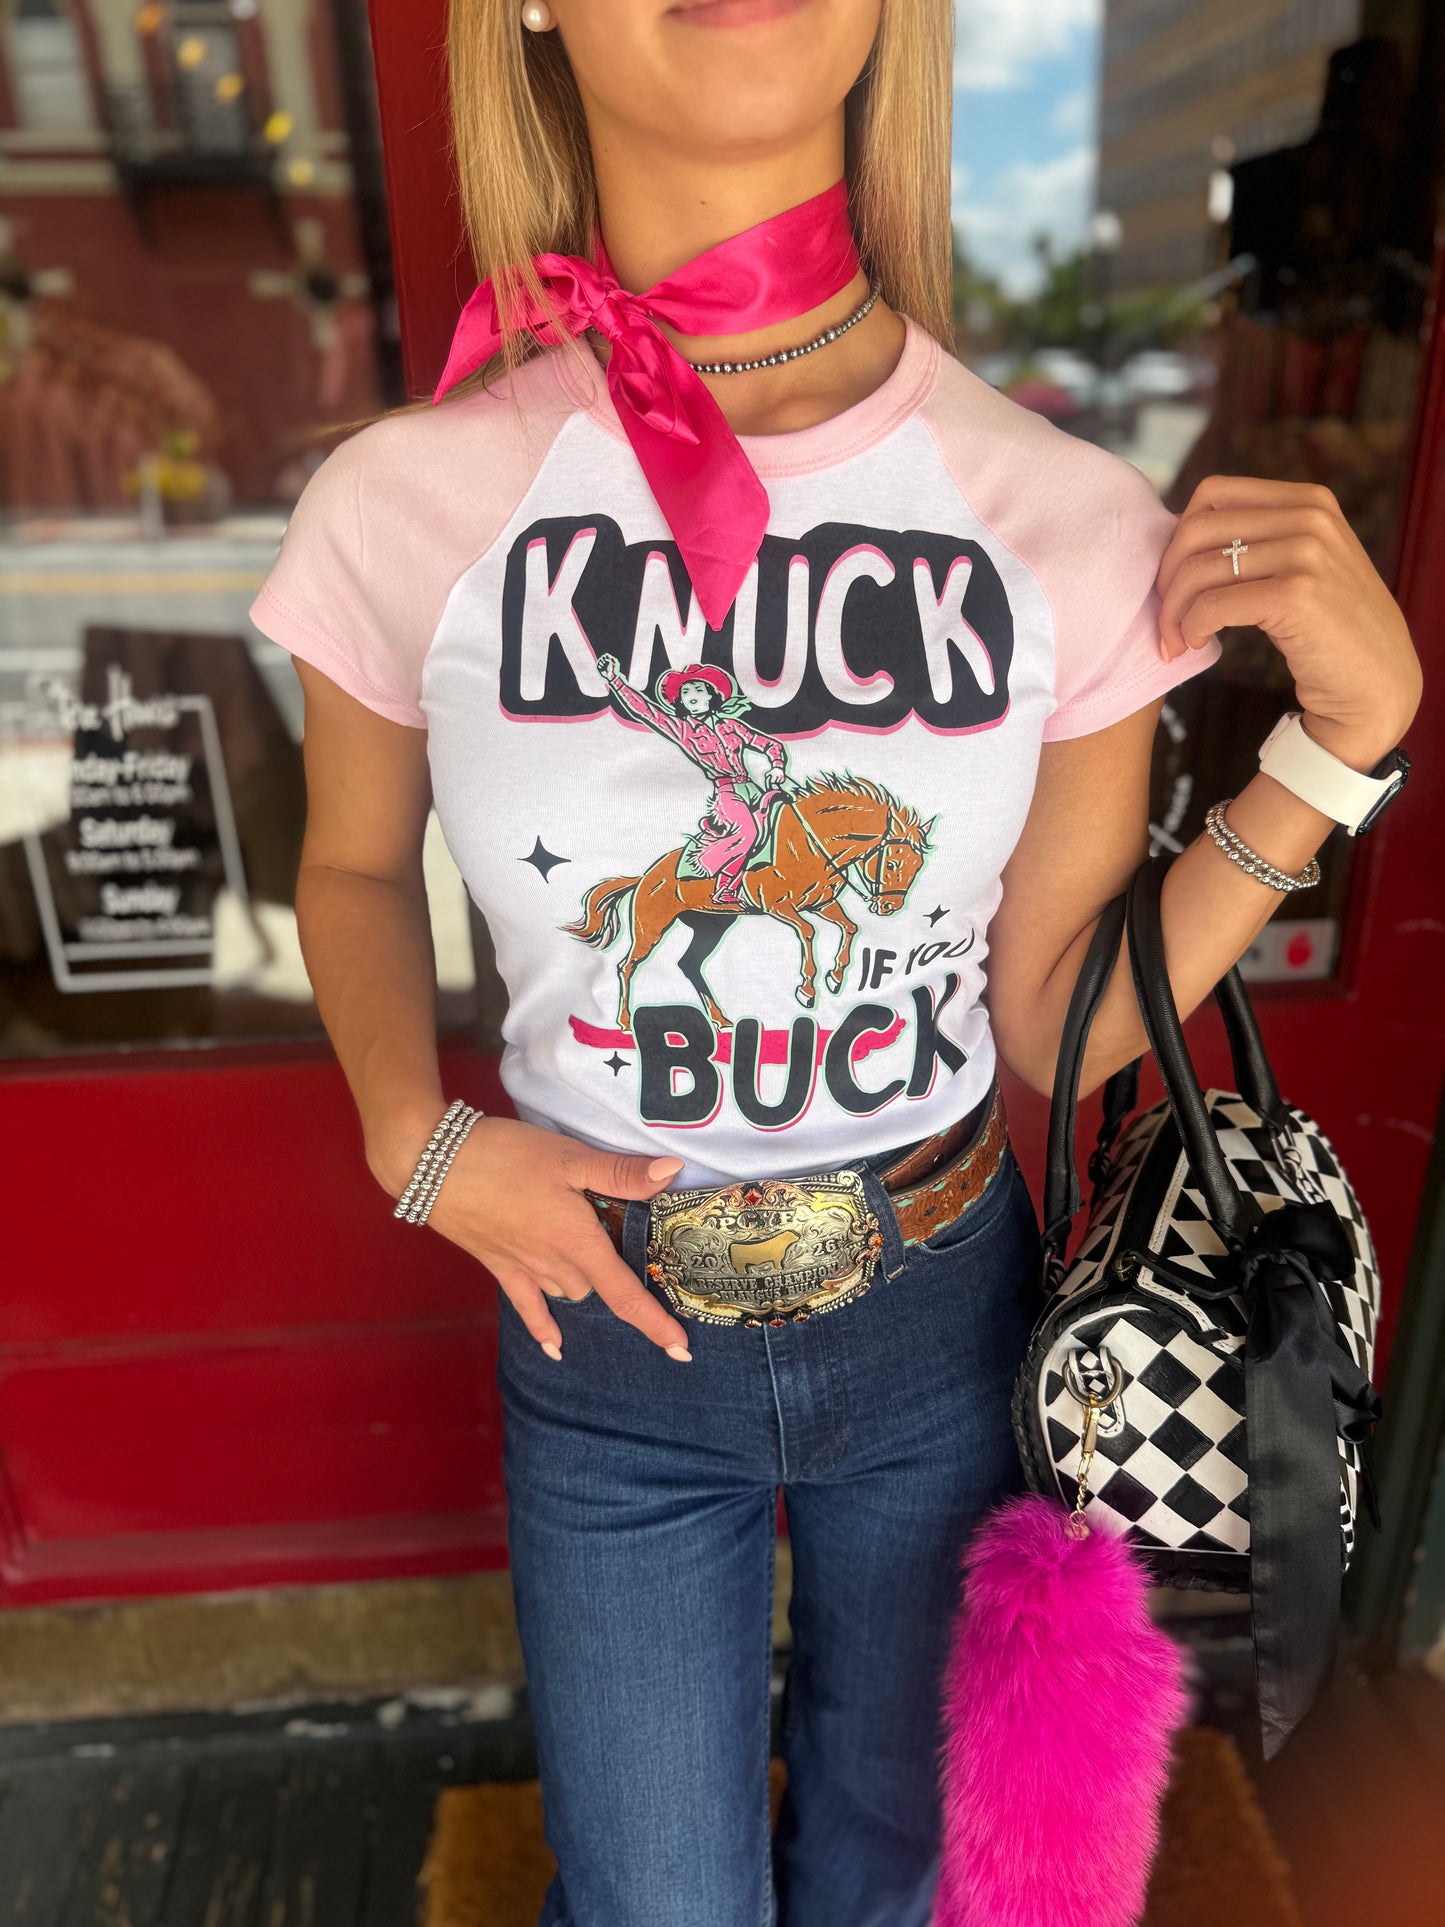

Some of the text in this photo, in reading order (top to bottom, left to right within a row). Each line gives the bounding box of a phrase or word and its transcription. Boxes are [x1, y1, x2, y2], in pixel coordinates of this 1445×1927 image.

[518, 527, 997, 709] KNUCK
[858, 928, 975, 992] IF YOU
[633, 973, 968, 1131] BUCK
[691, 1239, 837, 1269] 20 26
[696, 1263, 839, 1291] RESERVE CHAMPION
[787, 1281, 819, 1296] BULL
